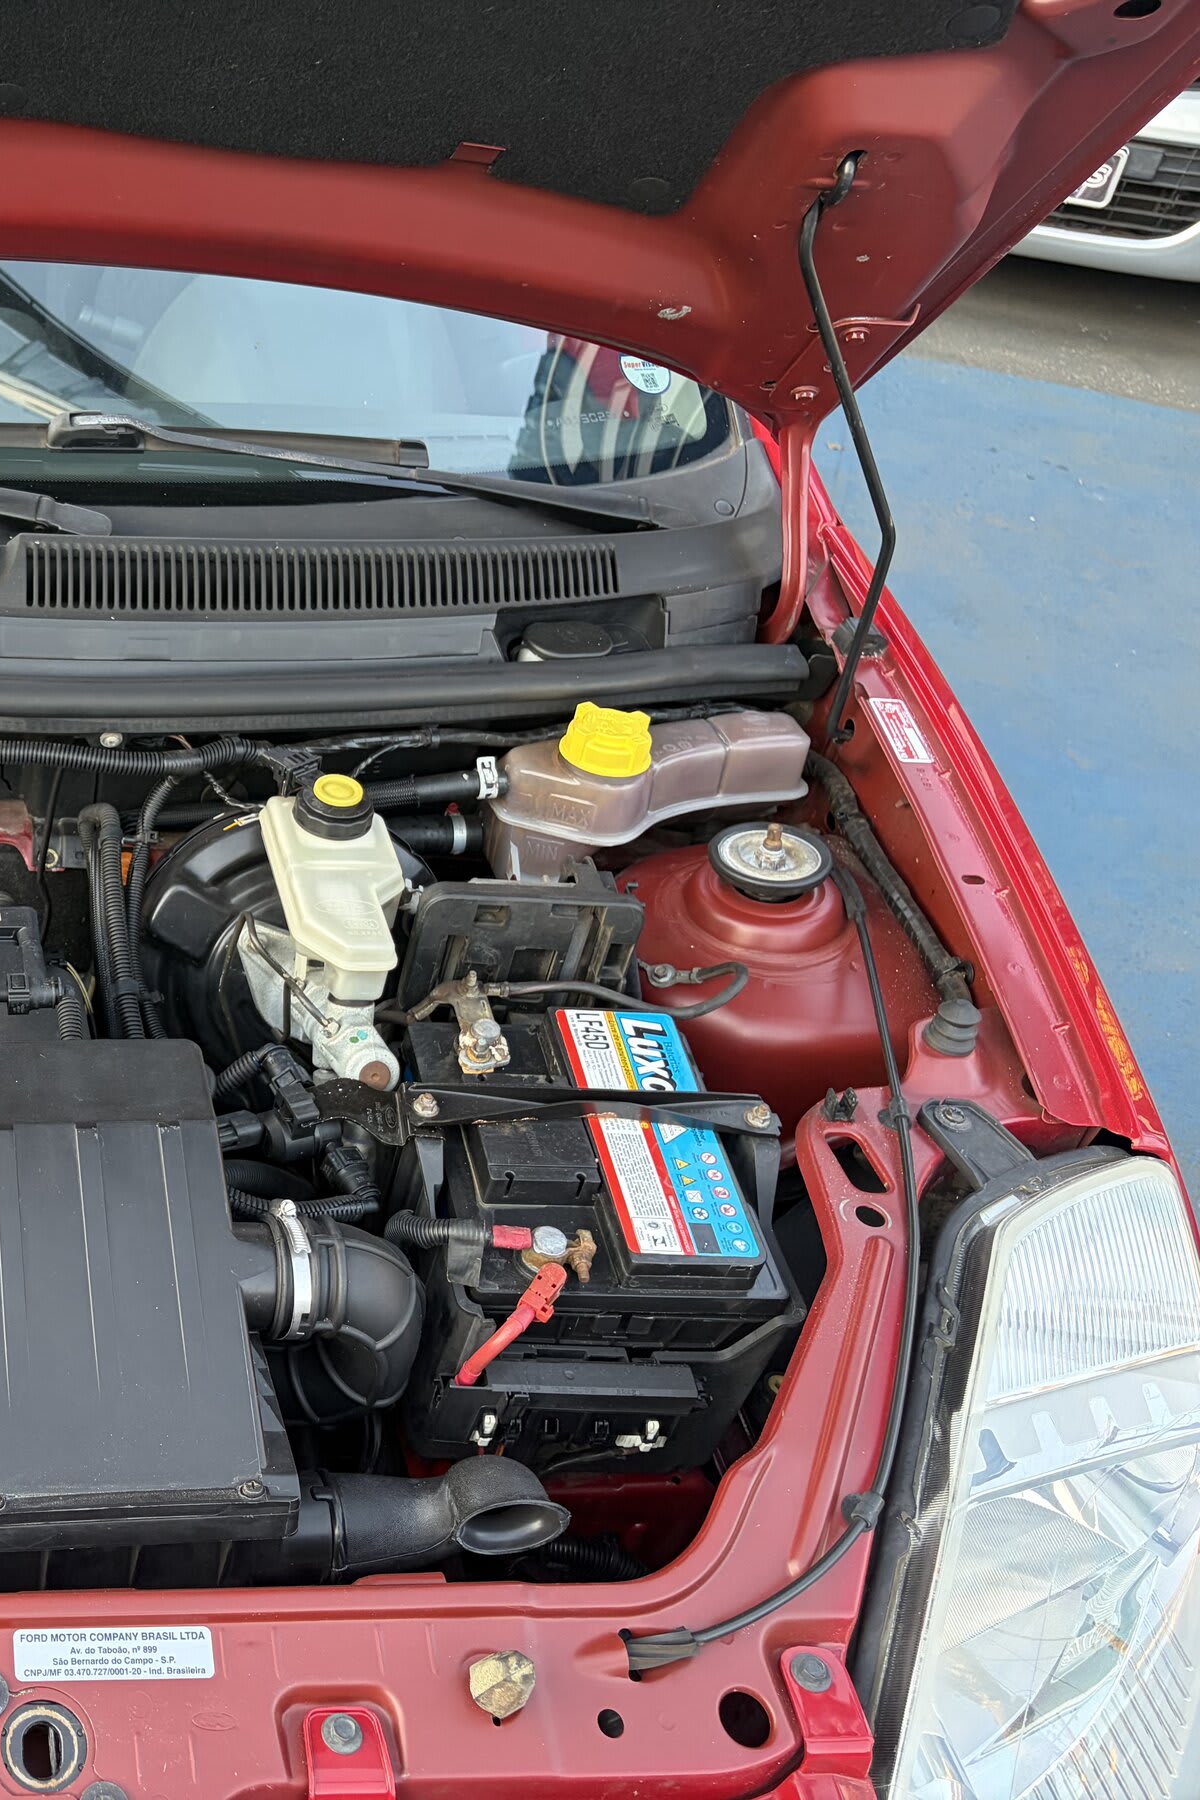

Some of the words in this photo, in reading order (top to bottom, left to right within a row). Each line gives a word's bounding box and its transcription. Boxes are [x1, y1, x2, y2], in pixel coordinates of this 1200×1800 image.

[552, 802, 592, 827] MAX
[576, 1012, 610, 1050] LF45D
[20, 1634, 48, 1642] FORD
[50, 1633, 87, 1642] MOTOR
[90, 1632, 138, 1642] COMPANY
[141, 1632, 178, 1640] BRASIL
[180, 1631, 205, 1640] LTDA
[70, 1646, 82, 1654] Av.
[84, 1646, 96, 1654] do
[142, 1646, 158, 1654] 899
[52, 1658, 68, 1666] São
[70, 1657, 110, 1666] Bernardo
[124, 1656, 154, 1666] Campo
[160, 1656, 176, 1664] S.P.
[24, 1668, 62, 1677] CNPJ/MF
[64, 1667, 142, 1676] 03.470.727/0001-20
[148, 1667, 164, 1675] Ind.
[166, 1666, 206, 1674] Brasileira
